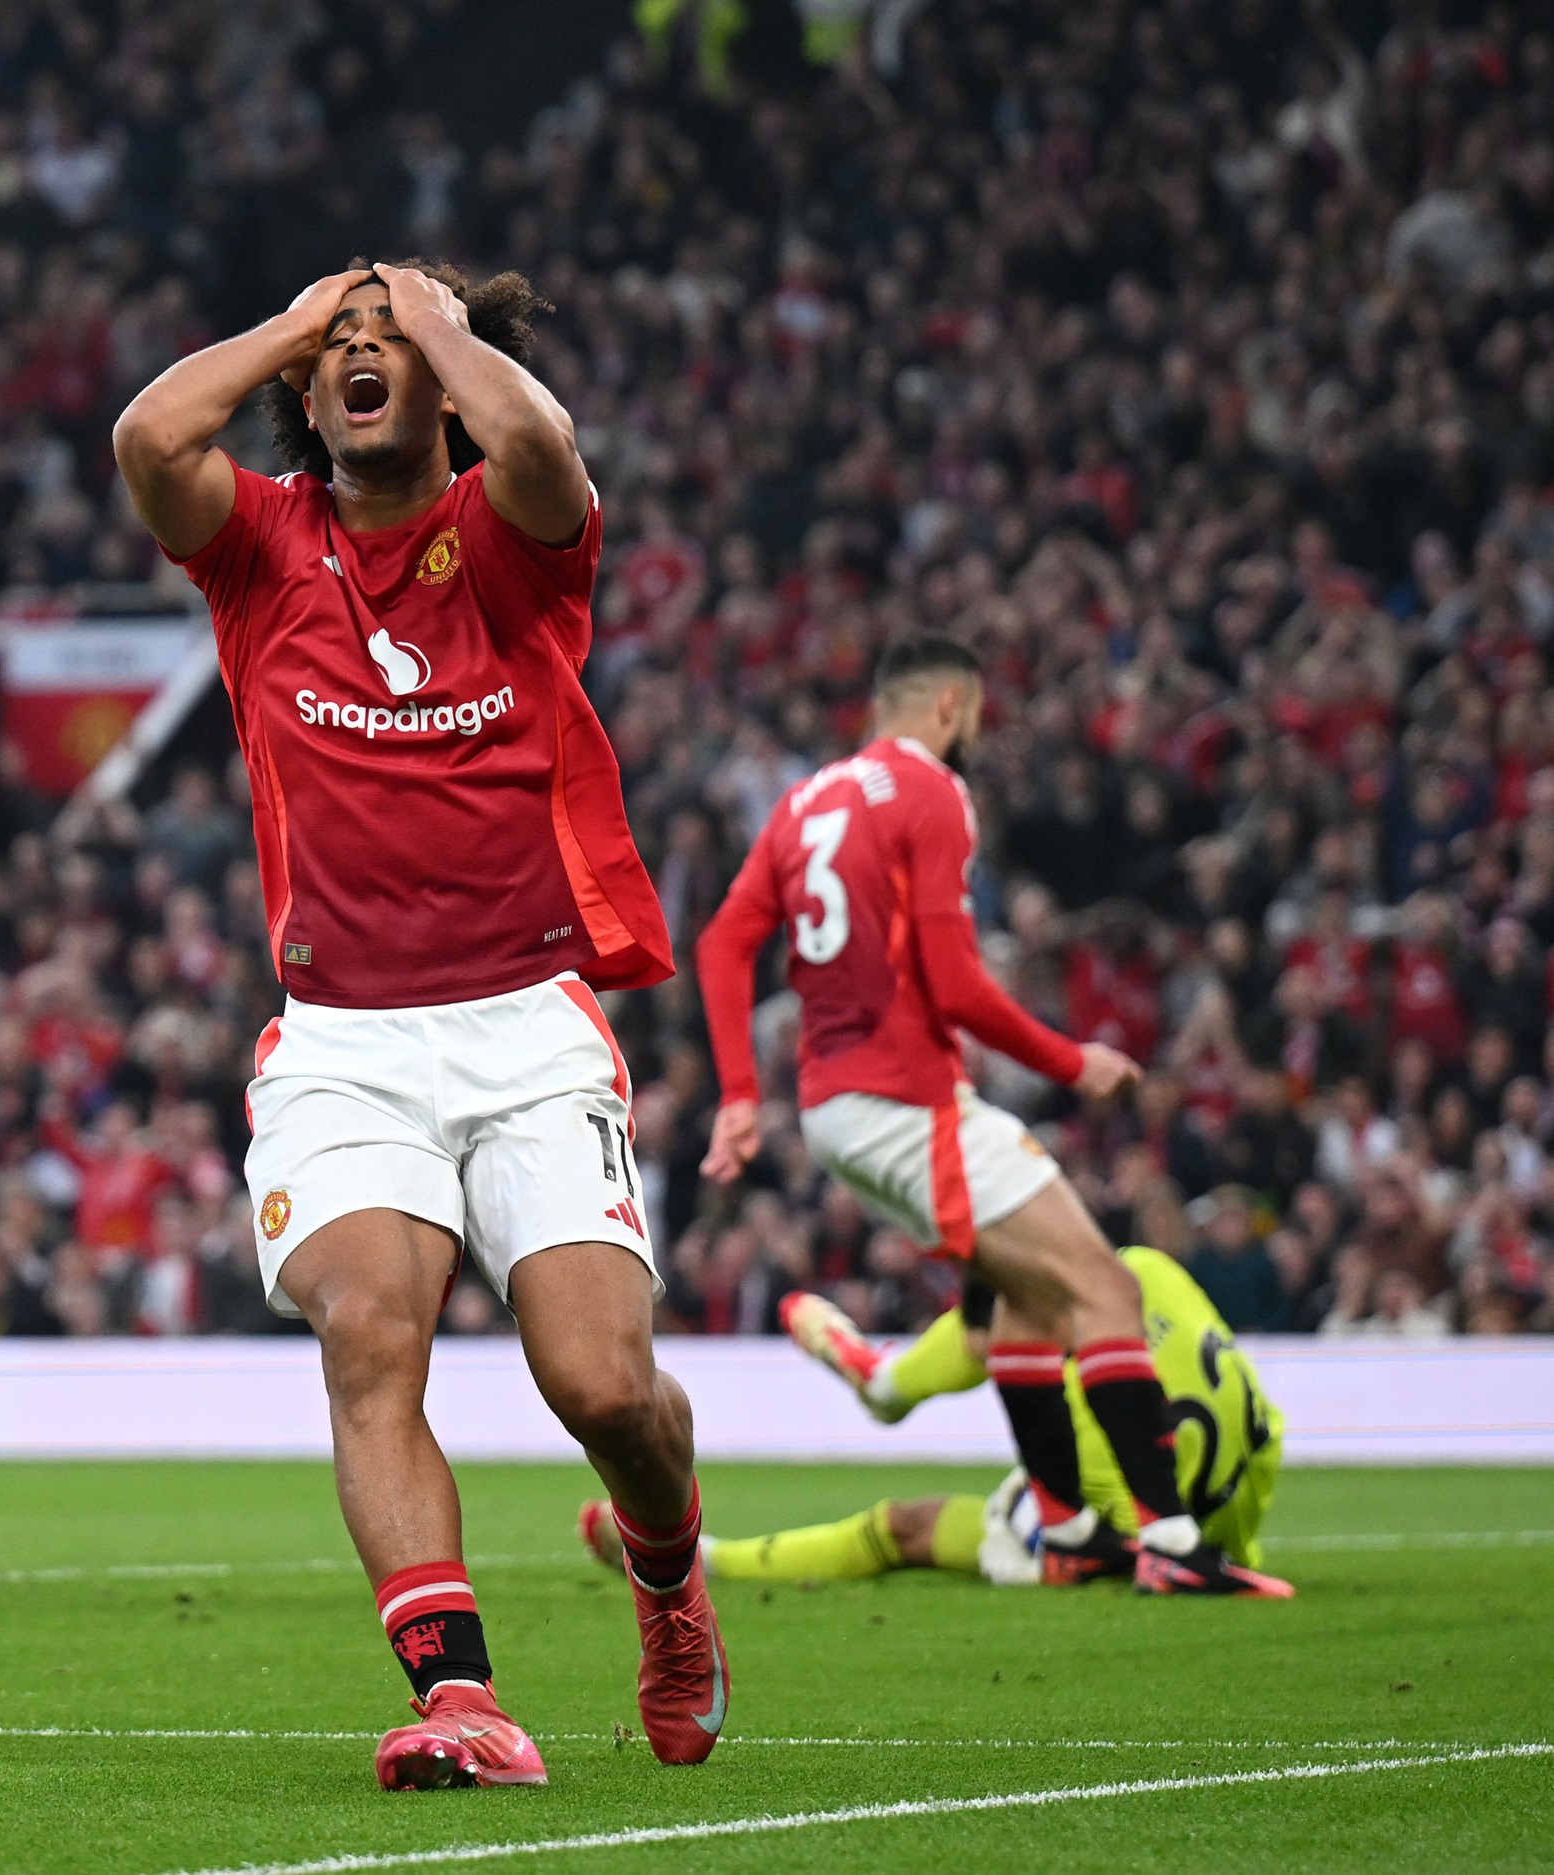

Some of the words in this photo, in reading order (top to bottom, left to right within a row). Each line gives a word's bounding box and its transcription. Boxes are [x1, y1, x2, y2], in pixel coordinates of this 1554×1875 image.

[430, 559, 459, 583] UNITED
[295, 685, 515, 739] Snapdragon
[796, 816, 851, 965] 3
[586, 1112, 634, 1199] 11
